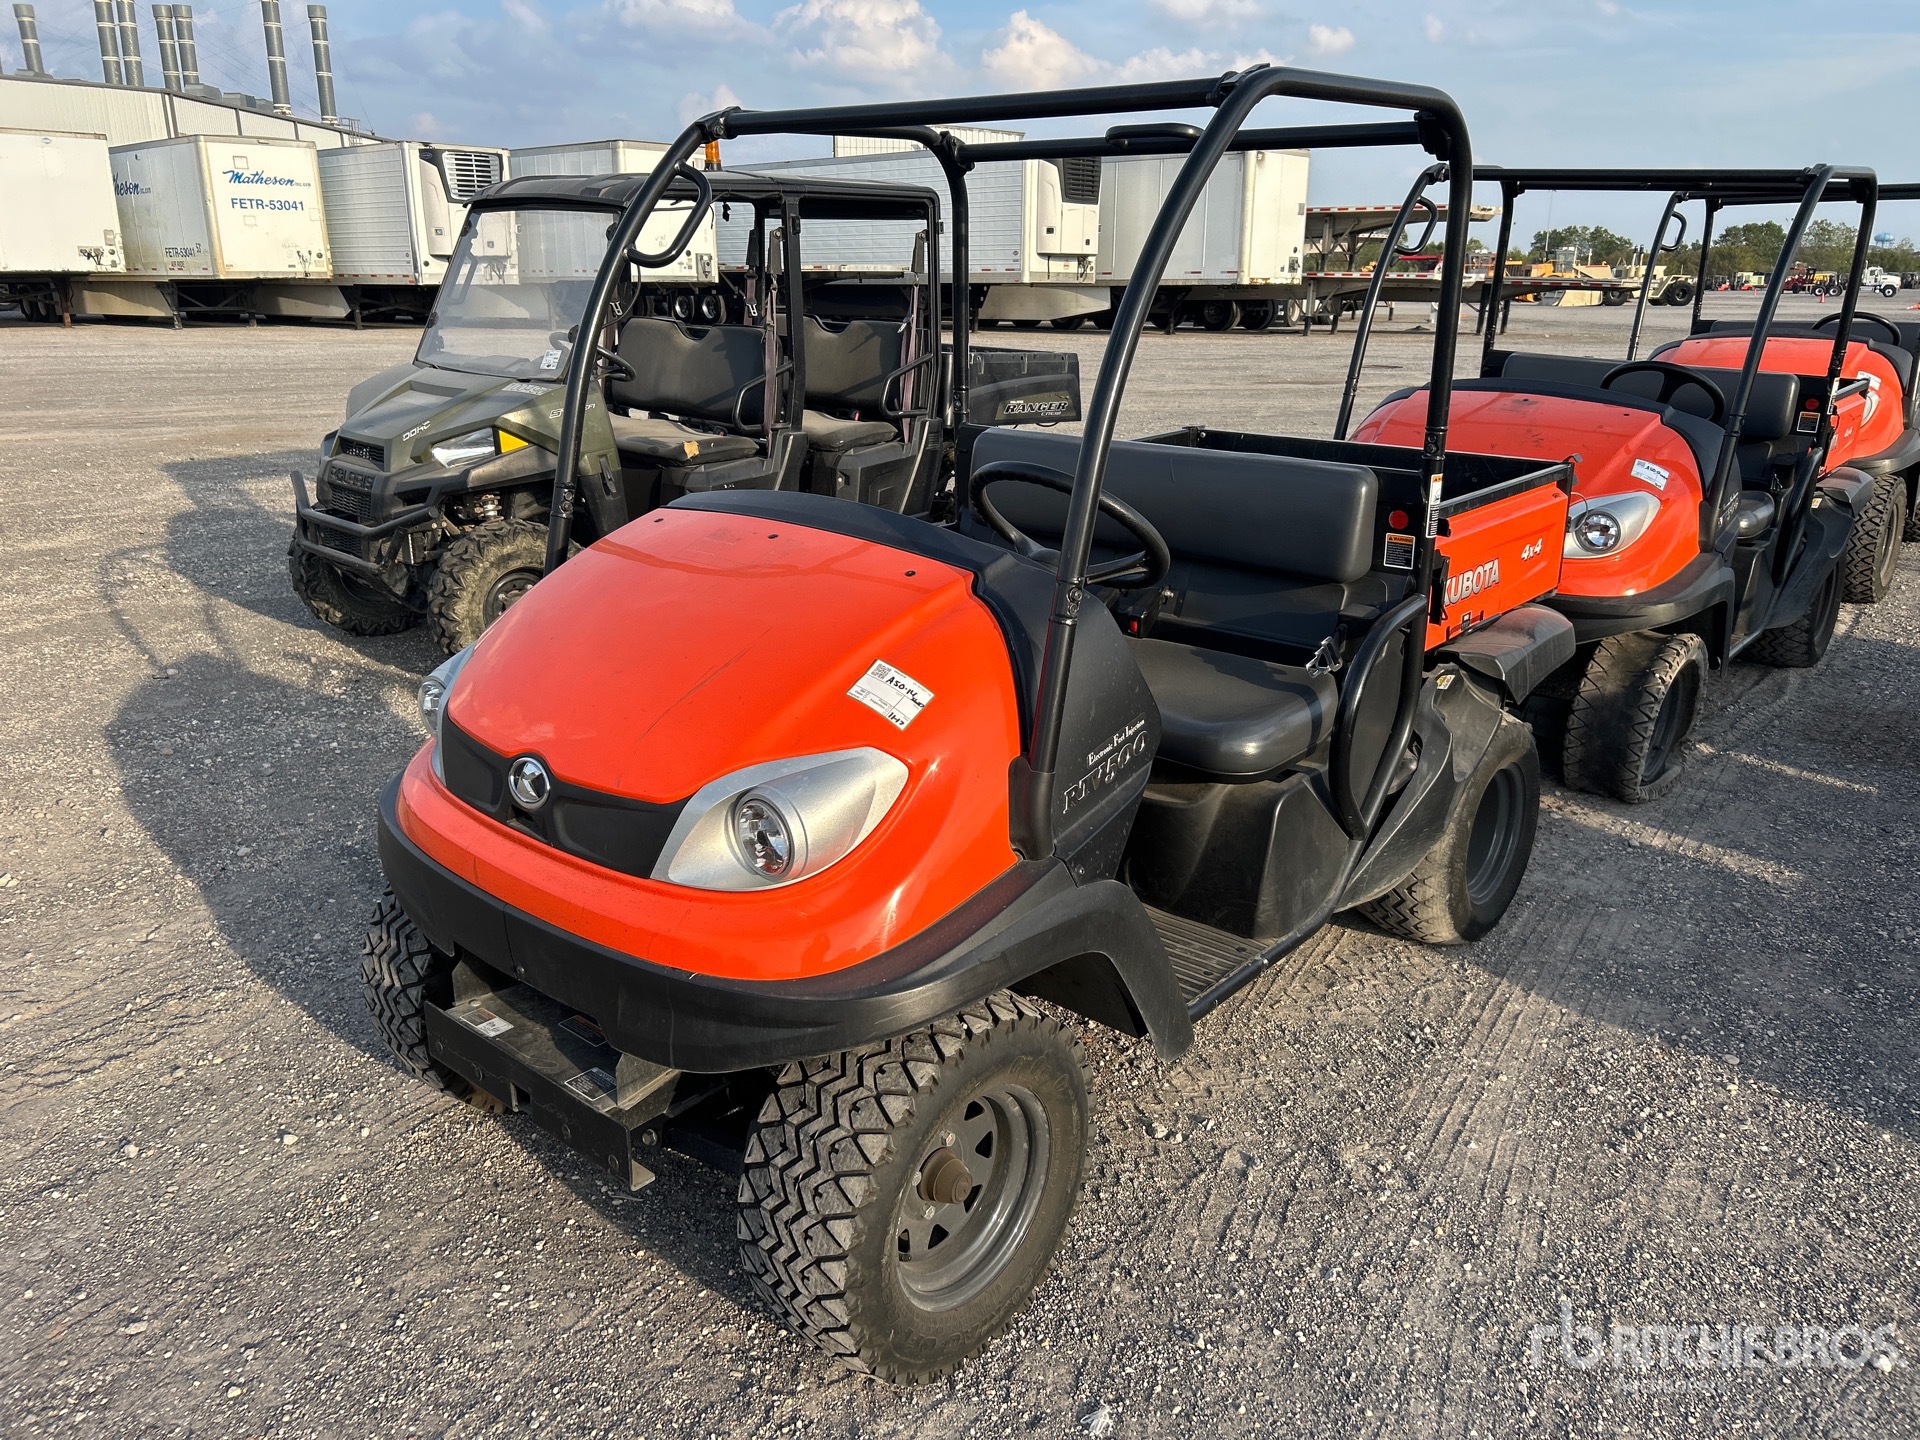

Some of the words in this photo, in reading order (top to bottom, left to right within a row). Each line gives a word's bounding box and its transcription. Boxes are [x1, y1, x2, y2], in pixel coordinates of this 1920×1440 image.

[222, 170, 295, 186] Matheson
[231, 198, 304, 211] FETR-53041
[165, 247, 196, 258] FETR-53041
[1004, 401, 1068, 414] RANGER
[329, 464, 374, 491] POLARIS
[1520, 537, 1543, 561] 4x4
[1087, 743, 1113, 766] Electronic
[1113, 733, 1125, 747] Fuel
[1125, 719, 1145, 738] Injection
